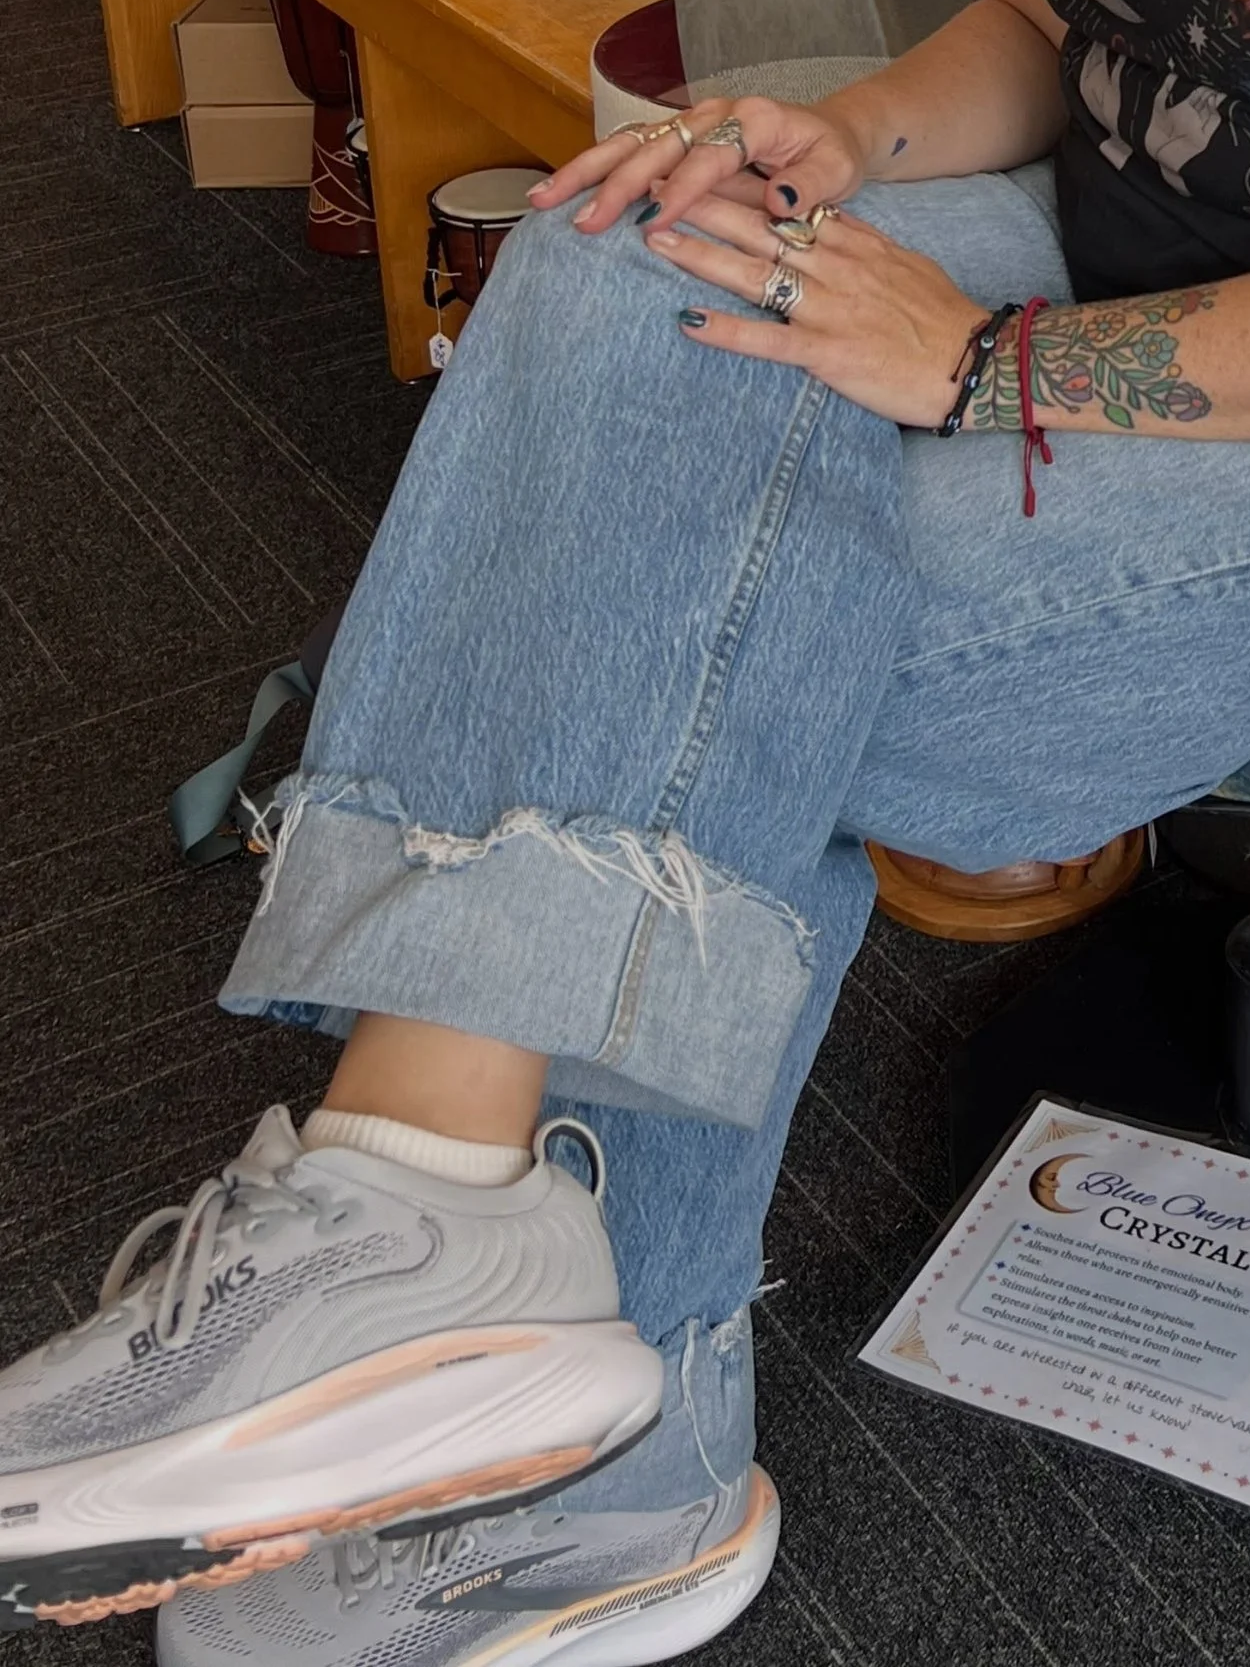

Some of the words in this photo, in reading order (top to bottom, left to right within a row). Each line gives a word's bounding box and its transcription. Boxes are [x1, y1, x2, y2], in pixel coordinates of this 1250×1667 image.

[1076, 1171, 1157, 1207] Blue
[1016, 1251, 1043, 1267] relax.
[1033, 1225, 1074, 1247] Soothes
[1075, 1238, 1096, 1253] and
[1096, 1244, 1140, 1269] protects
[1141, 1257, 1159, 1272] the
[1160, 1266, 1216, 1290] emotional
[1216, 1281, 1245, 1300] body.
[1100, 1206, 1250, 1272] CRYSTAL
[128, 1254, 257, 1361] BOKS
[1007, 1263, 1065, 1289] Stimulates
[1066, 1282, 1091, 1297] ones
[1092, 1290, 1126, 1309] access
[1127, 1300, 1140, 1313] to
[1140, 1303, 1198, 1331] inspiration.
[1024, 1238, 1059, 1257] Allows
[1060, 1247, 1090, 1265] those
[1091, 1258, 1113, 1273] who
[1114, 1266, 1133, 1279] are
[1134, 1271, 1200, 1301] energetically
[1202, 1293, 1250, 1316] sensitive
[981, 1304, 1049, 1335] explorations,
[1052, 1326, 1065, 1338] in
[1131, 1349, 1143, 1361] or
[1142, 1353, 1162, 1368] art.
[991, 1290, 1031, 1314] express
[1032, 1303, 1075, 1327] insights
[1075, 1316, 1098, 1331] one
[1098, 1323, 1141, 1346] receives
[1142, 1335, 1170, 1355] from
[1171, 1346, 1202, 1365] inner
[999, 1276, 1057, 1303] Stimulates
[1057, 1293, 1076, 1308] the
[1076, 1298, 1107, 1318] throat
[1107, 1310, 1142, 1330] chakra
[1142, 1321, 1155, 1333] to
[1156, 1324, 1181, 1344] help
[1181, 1335, 1203, 1350] one
[1203, 1340, 1238, 1360] better
[960, 1329, 989, 1346] you
[1107, 1375, 1118, 1386] a
[1101, 1387, 1121, 1406] let
[1125, 1399, 1145, 1415] us
[441, 1568, 503, 1604] BROOKS
